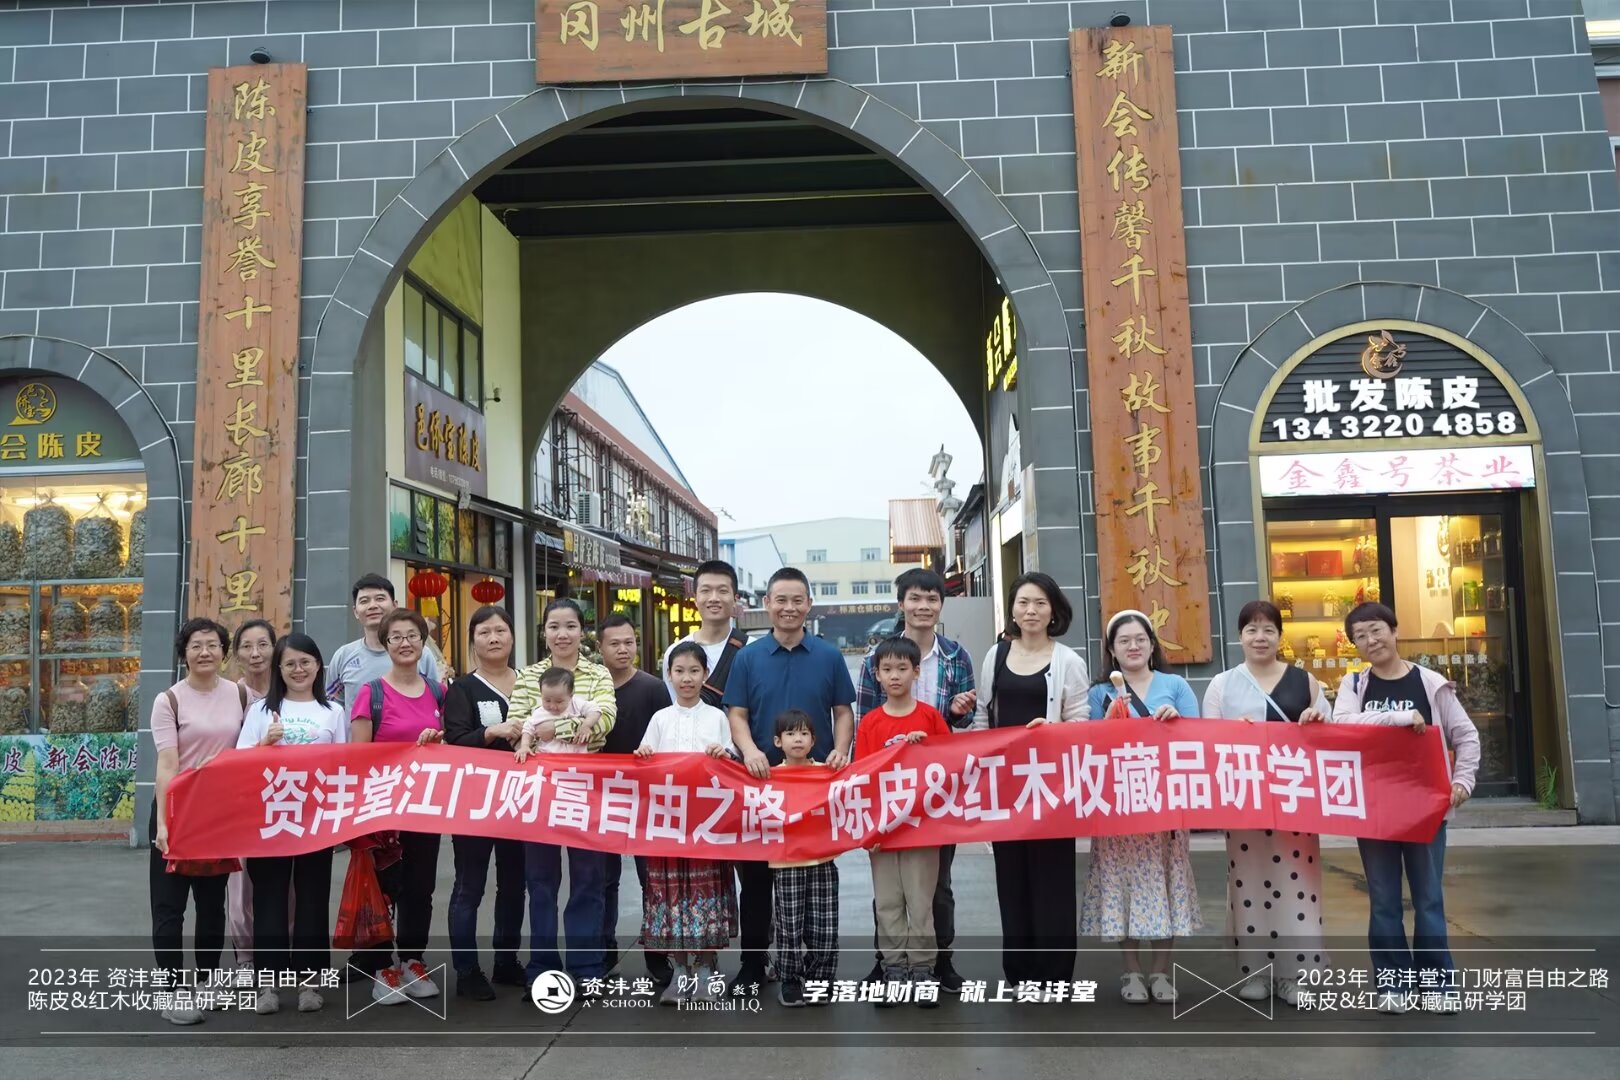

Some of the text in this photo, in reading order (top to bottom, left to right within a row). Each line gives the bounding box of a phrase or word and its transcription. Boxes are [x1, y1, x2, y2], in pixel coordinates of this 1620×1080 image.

[560, 0, 803, 53] 冈州古城
[215, 82, 277, 672] 陈皮享誉十里长廊十里
[1303, 376, 1480, 414] 批发陈皮
[1272, 411, 1517, 441] 134 3220 4858
[0, 432, 104, 460] 会陈皮
[1279, 453, 1522, 490] 金鑫号茶业
[2, 746, 27, 775] 皮
